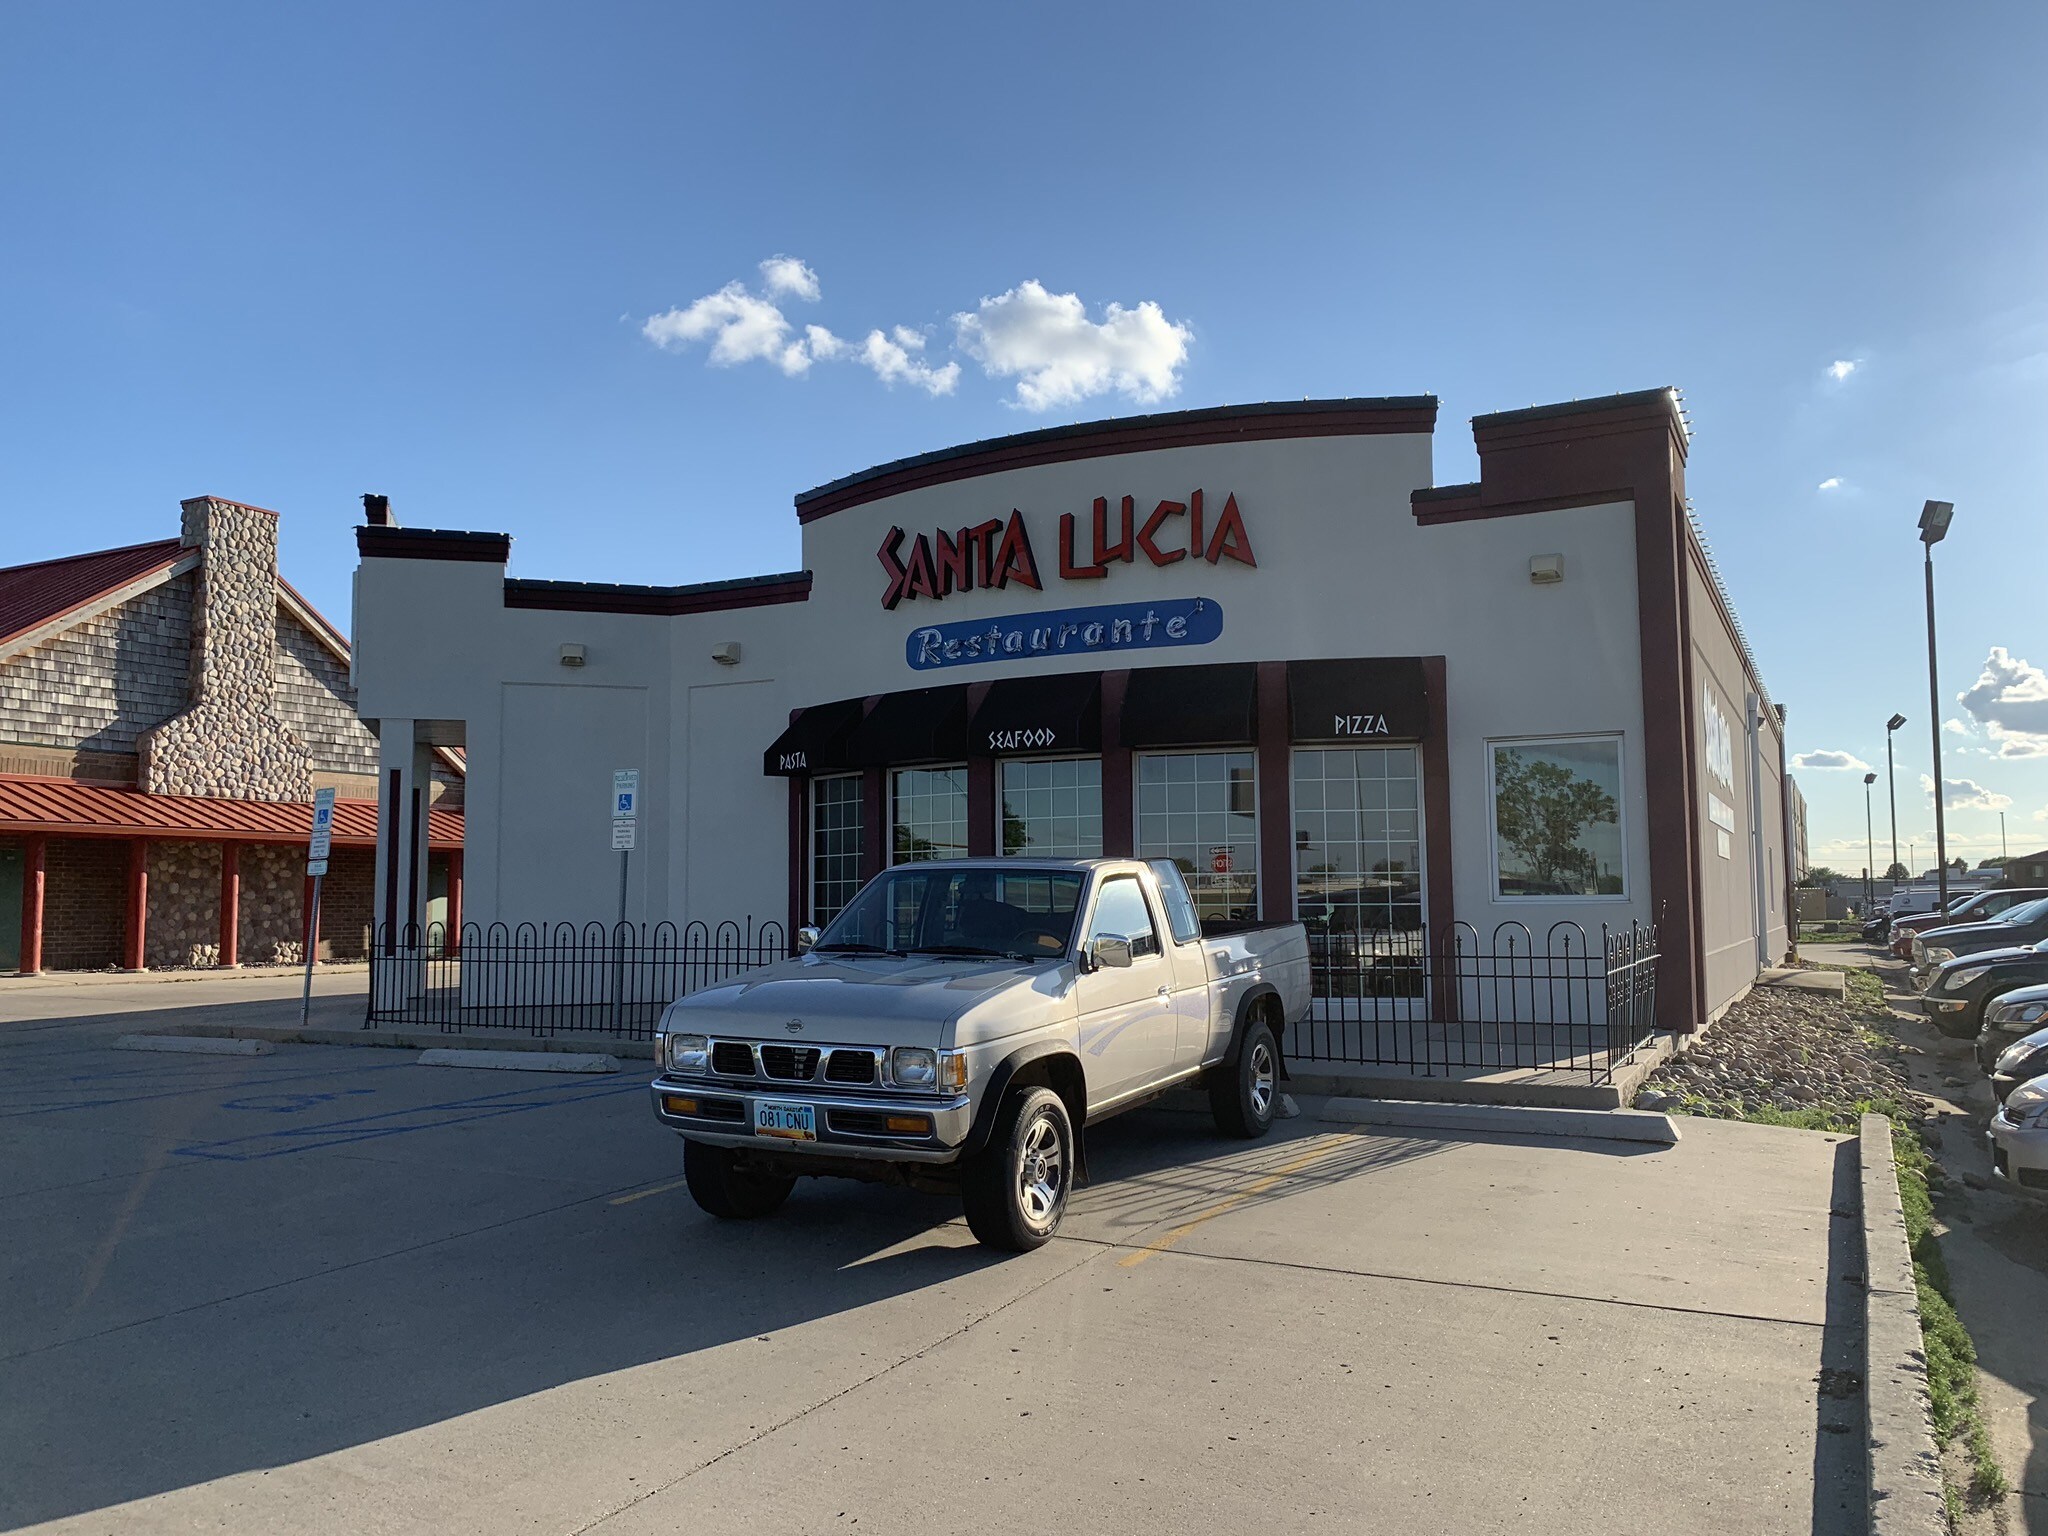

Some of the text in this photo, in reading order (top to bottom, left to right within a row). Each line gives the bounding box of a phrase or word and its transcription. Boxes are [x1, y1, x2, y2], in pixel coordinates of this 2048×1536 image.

[877, 488, 1257, 611] SANTA LUCIA
[915, 610, 1188, 665] Restaurante
[1335, 714, 1389, 735] PIZZA
[988, 727, 1056, 750] SEAFOOD
[780, 751, 807, 770] PASTA
[760, 1110, 809, 1131] 081 CNU
